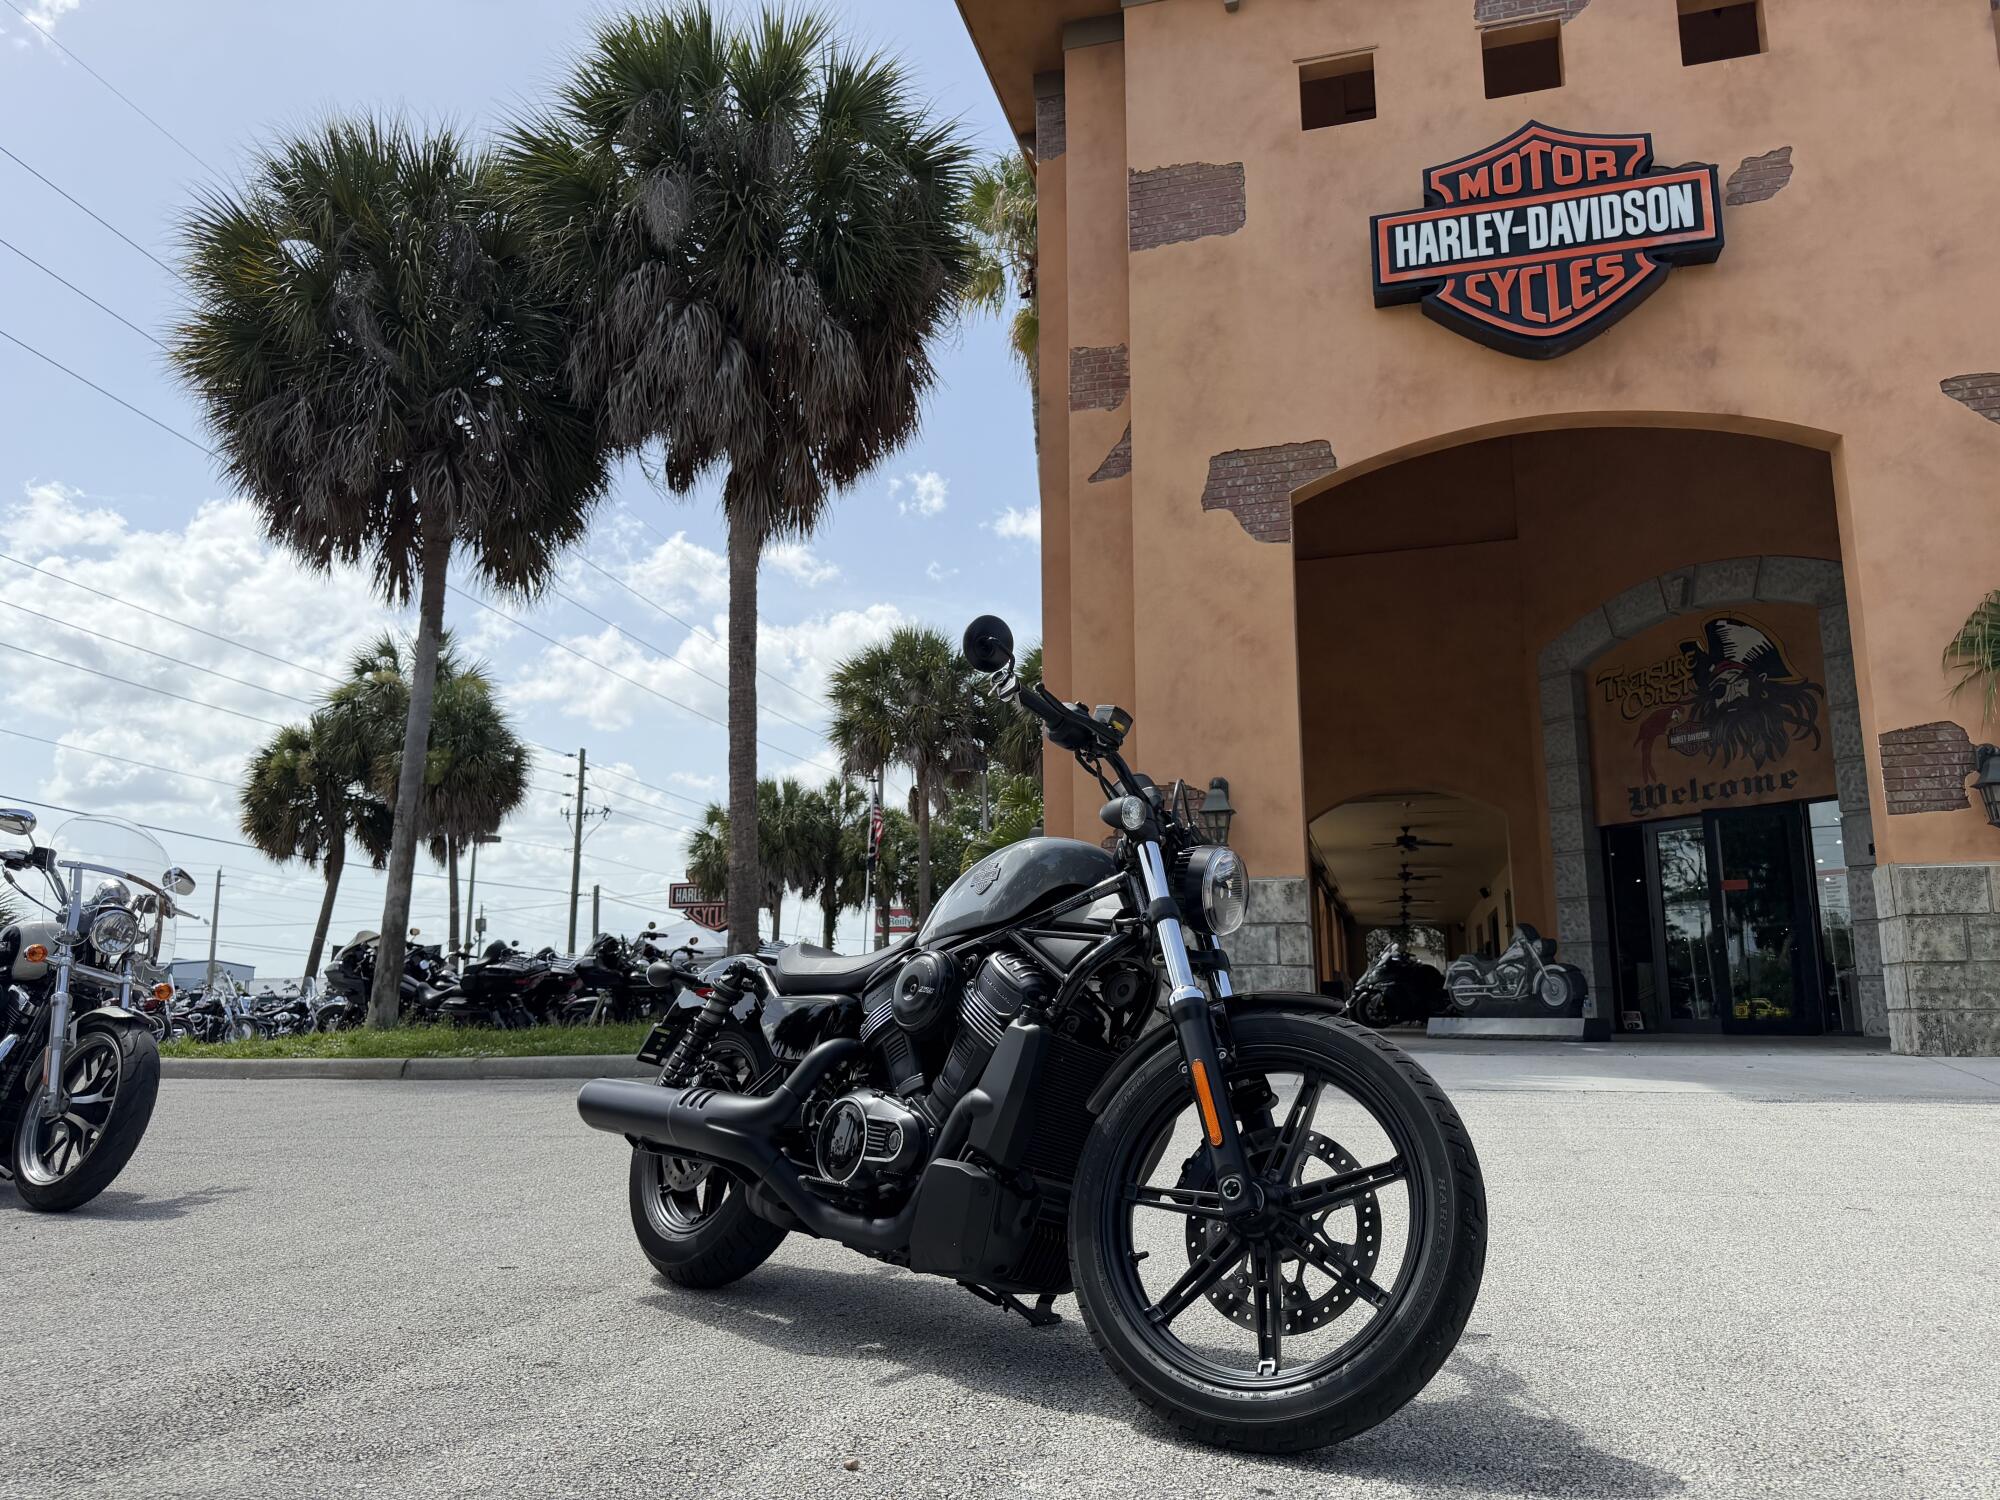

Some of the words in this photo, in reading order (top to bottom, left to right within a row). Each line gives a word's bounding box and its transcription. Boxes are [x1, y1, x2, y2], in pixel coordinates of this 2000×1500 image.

[1459, 140, 1617, 200] MOTOR
[1395, 183, 1695, 268] HARLEY-DAVIDSON
[1465, 254, 1626, 323] CYCLES
[1628, 769, 1798, 816] Welcome
